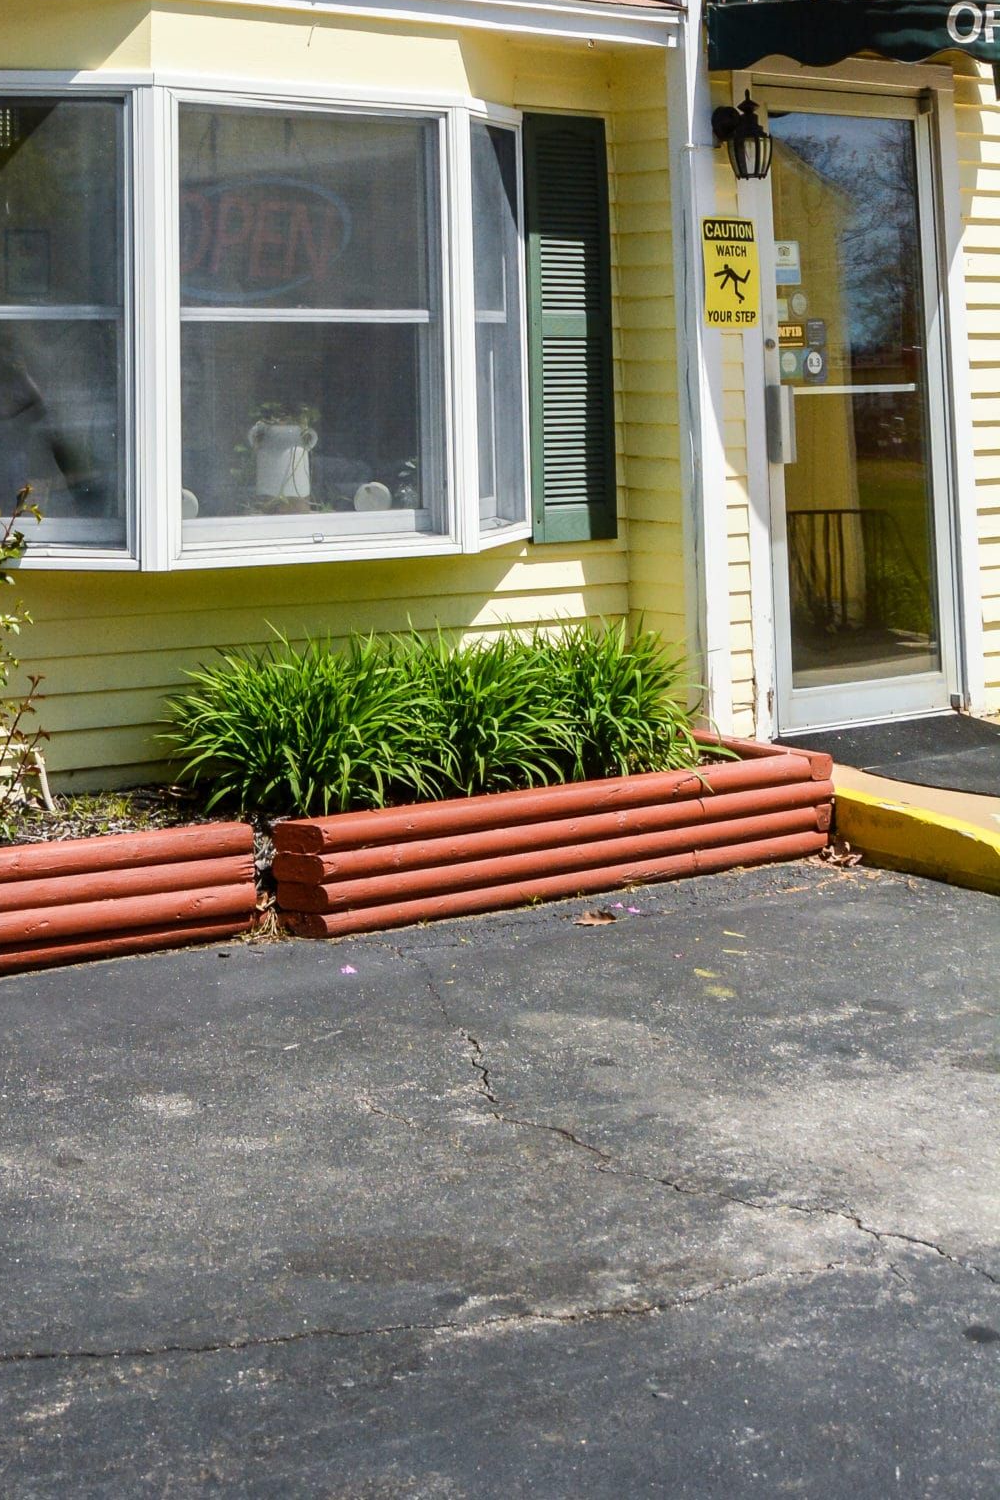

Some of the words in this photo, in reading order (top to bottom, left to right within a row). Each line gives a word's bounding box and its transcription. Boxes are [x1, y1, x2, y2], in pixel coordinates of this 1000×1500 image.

[705, 222, 753, 239] CAUTION
[179, 192, 337, 283] OPEN
[716, 244, 747, 257] WATCH
[708, 310, 733, 323] YOUR
[735, 311, 756, 323] STEP
[808, 357, 821, 368] 8.3
